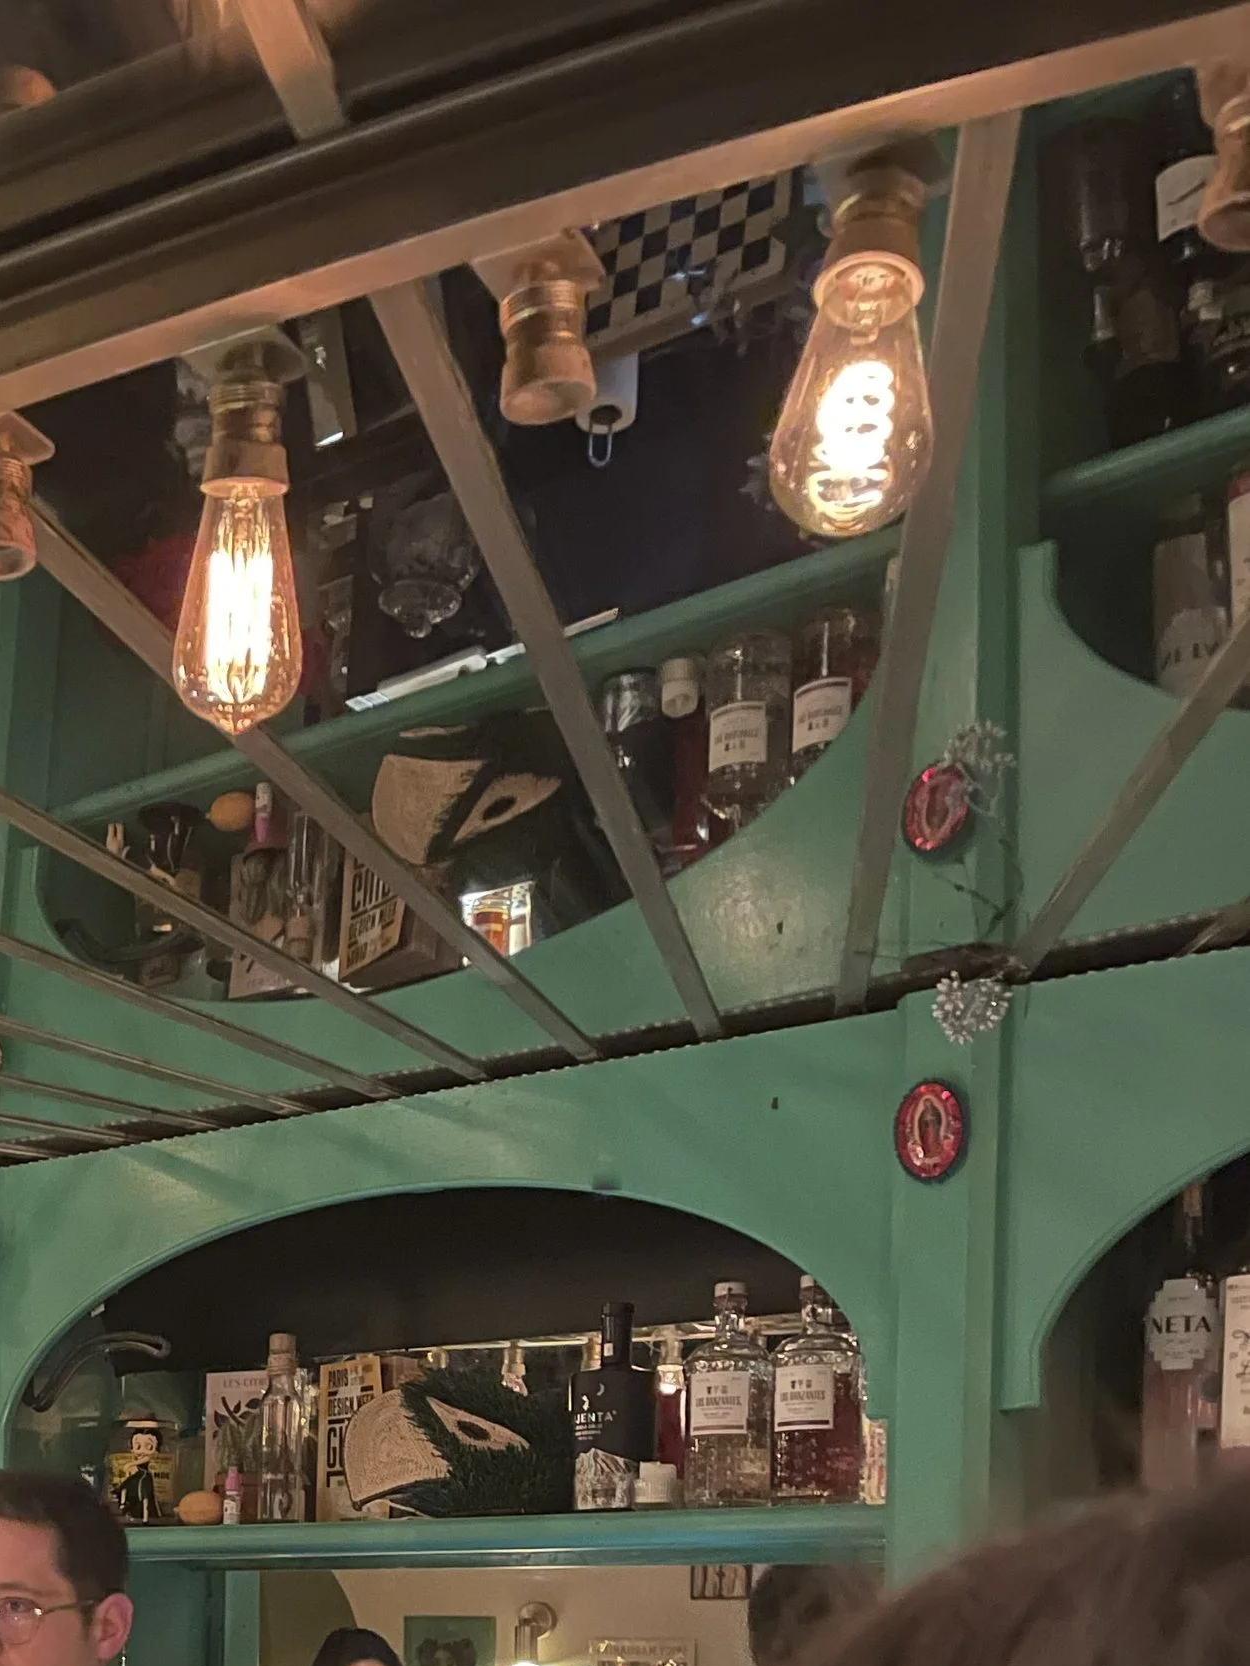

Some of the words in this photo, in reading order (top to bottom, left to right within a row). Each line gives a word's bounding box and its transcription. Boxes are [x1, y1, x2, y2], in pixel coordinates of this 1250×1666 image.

[1151, 1314, 1211, 1335] NETA
[328, 1367, 349, 1389] PARIS
[328, 1395, 354, 1417] DESIGN
